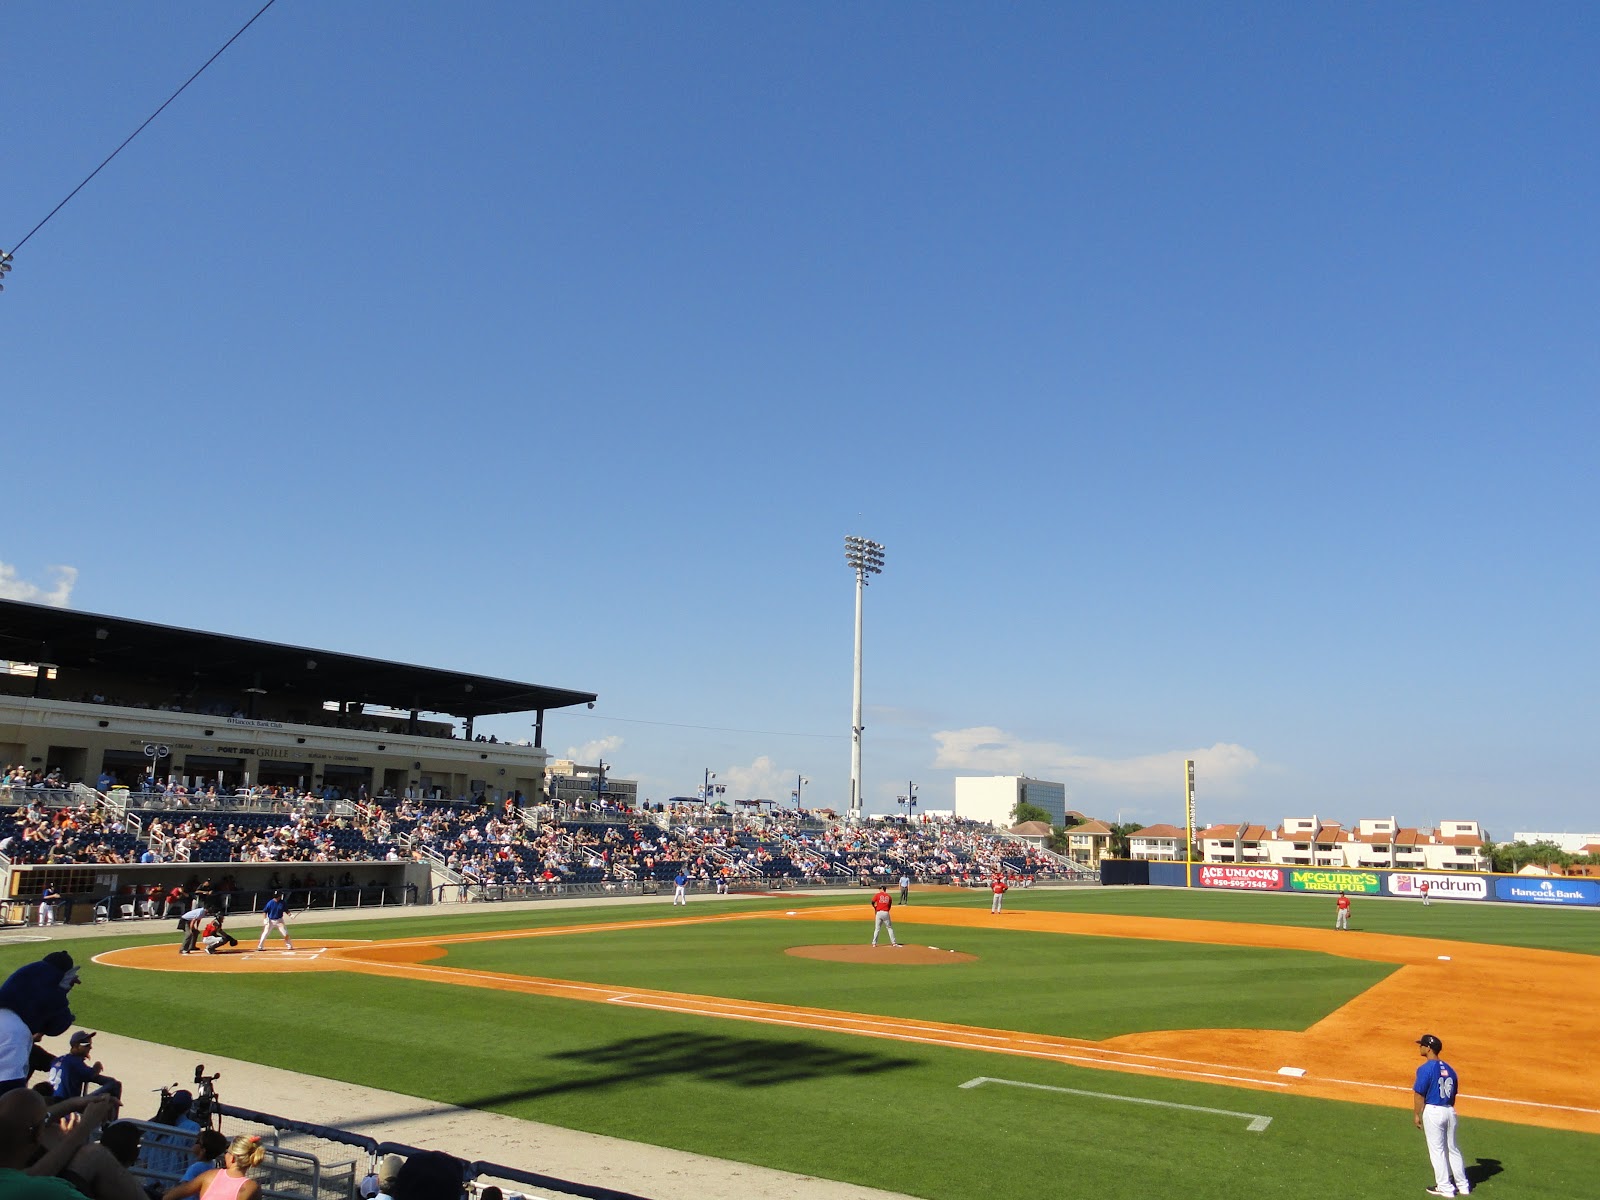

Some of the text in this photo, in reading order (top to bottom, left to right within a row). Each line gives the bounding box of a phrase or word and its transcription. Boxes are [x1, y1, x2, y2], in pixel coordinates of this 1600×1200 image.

[256, 748, 289, 758] GRILLE
[1202, 867, 1279, 881] ACE UNLOCKS
[1213, 878, 1267, 888] 850-505-7545
[1340, 884, 1365, 892] PUB
[1511, 888, 1554, 897] Hancock
[1438, 1077, 1453, 1099] 16
